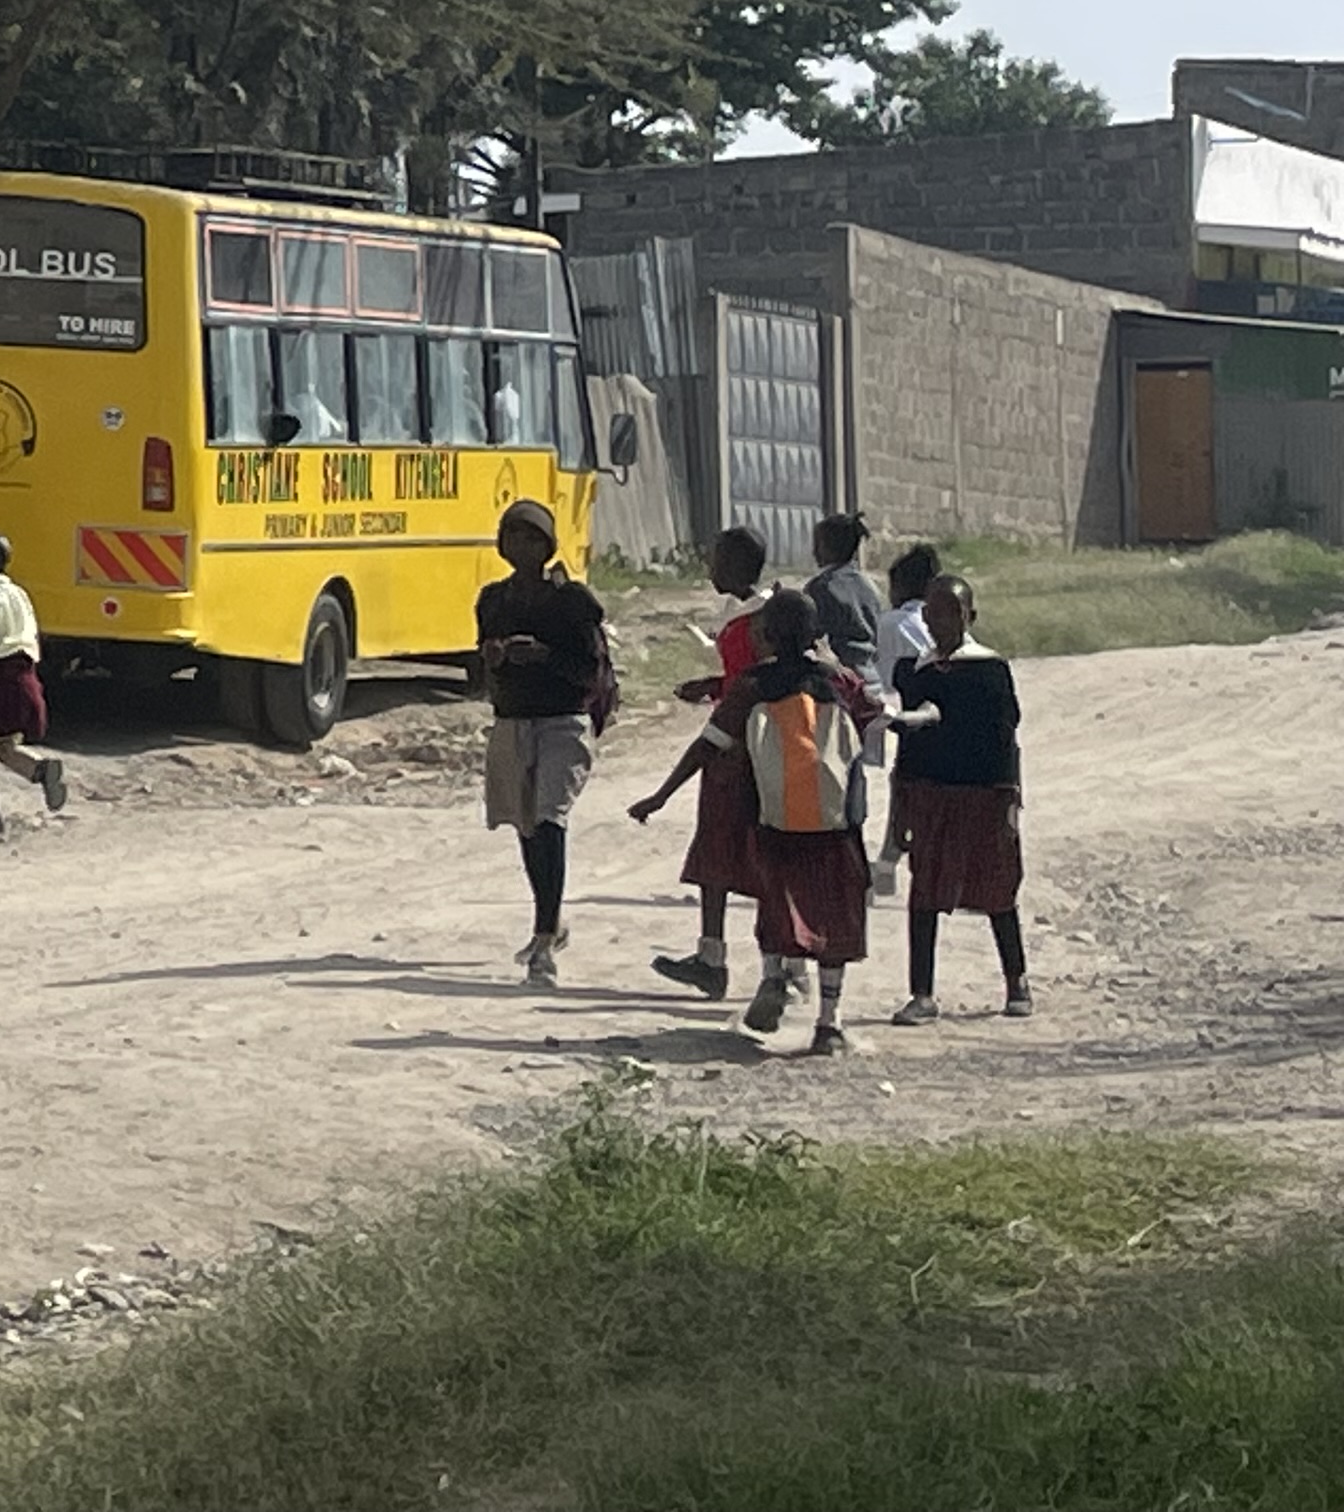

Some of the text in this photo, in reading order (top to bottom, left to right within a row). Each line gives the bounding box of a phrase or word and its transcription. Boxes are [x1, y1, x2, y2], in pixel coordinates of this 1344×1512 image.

[41, 249, 117, 279] BUS
[59, 315, 85, 332] TO
[322, 452, 372, 504] SCHOOL
